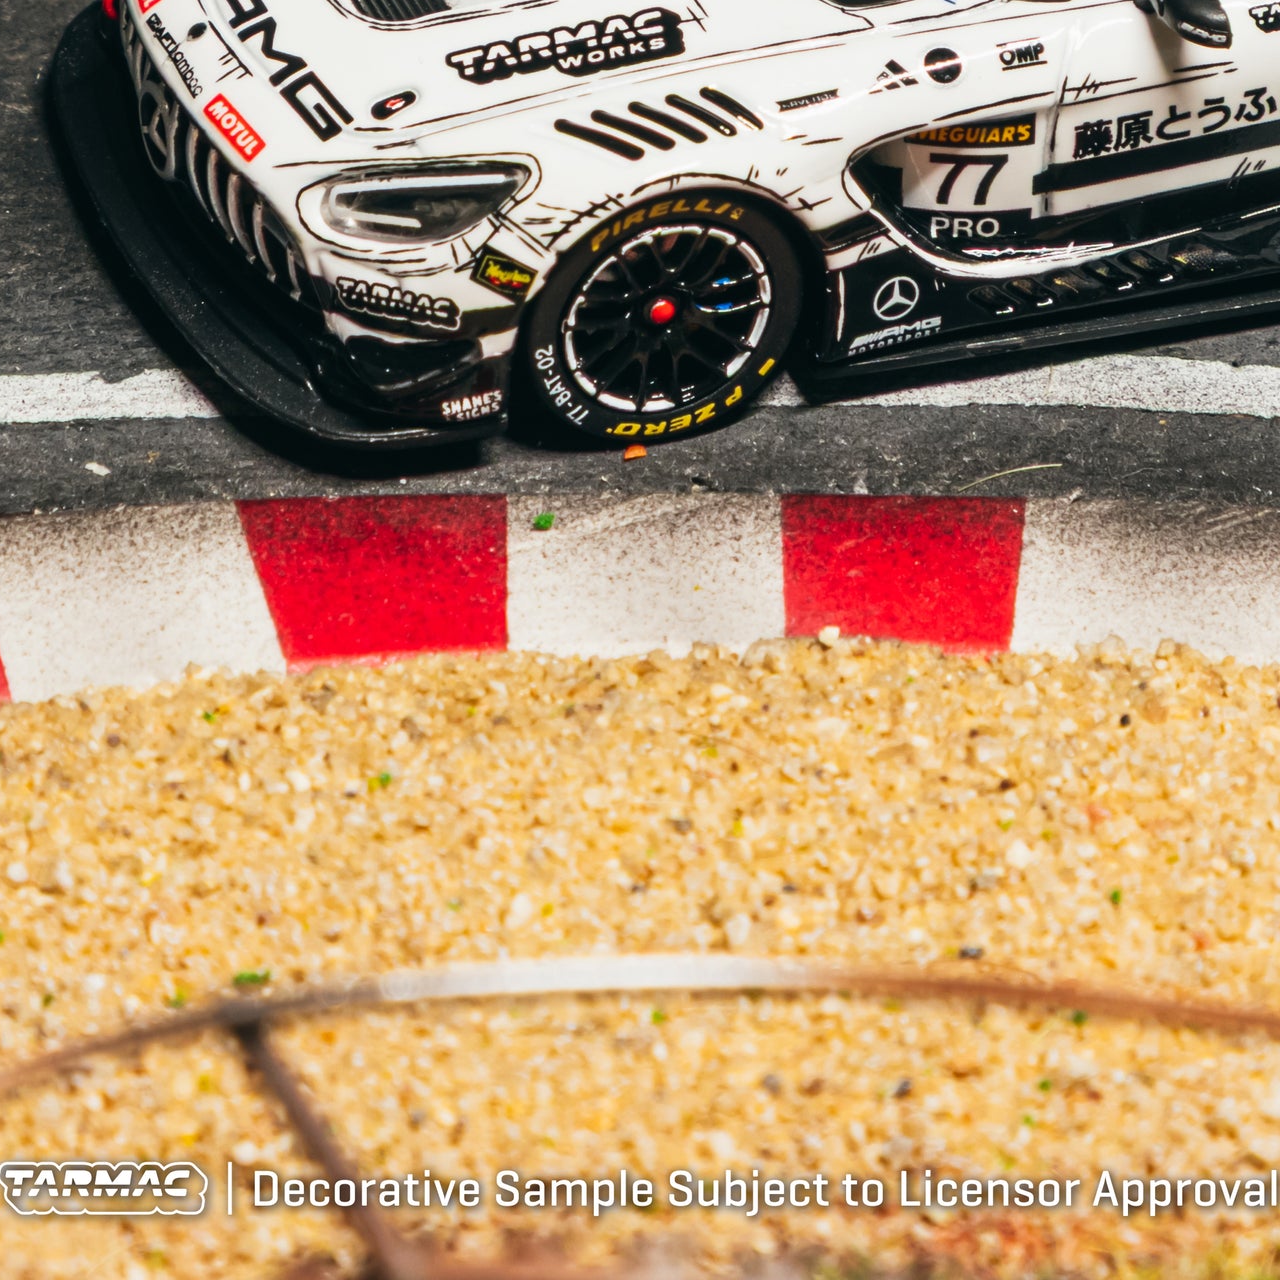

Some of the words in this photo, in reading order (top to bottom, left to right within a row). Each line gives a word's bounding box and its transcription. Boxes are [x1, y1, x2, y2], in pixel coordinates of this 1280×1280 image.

[451, 10, 665, 76] TARMAC
[558, 37, 666, 70] WORKS
[999, 42, 1045, 66] OMP
[207, 100, 260, 156] MOTUL
[930, 153, 1009, 206] 77
[592, 198, 732, 252] PIRELLI
[930, 216, 1000, 239] PRO
[338, 279, 451, 318] TARMAC
[848, 326, 941, 357] MOTORSPORT
[535, 344, 590, 425] 77-BAT-02
[725, 385, 744, 407] P
[612, 402, 716, 437] ZERO
